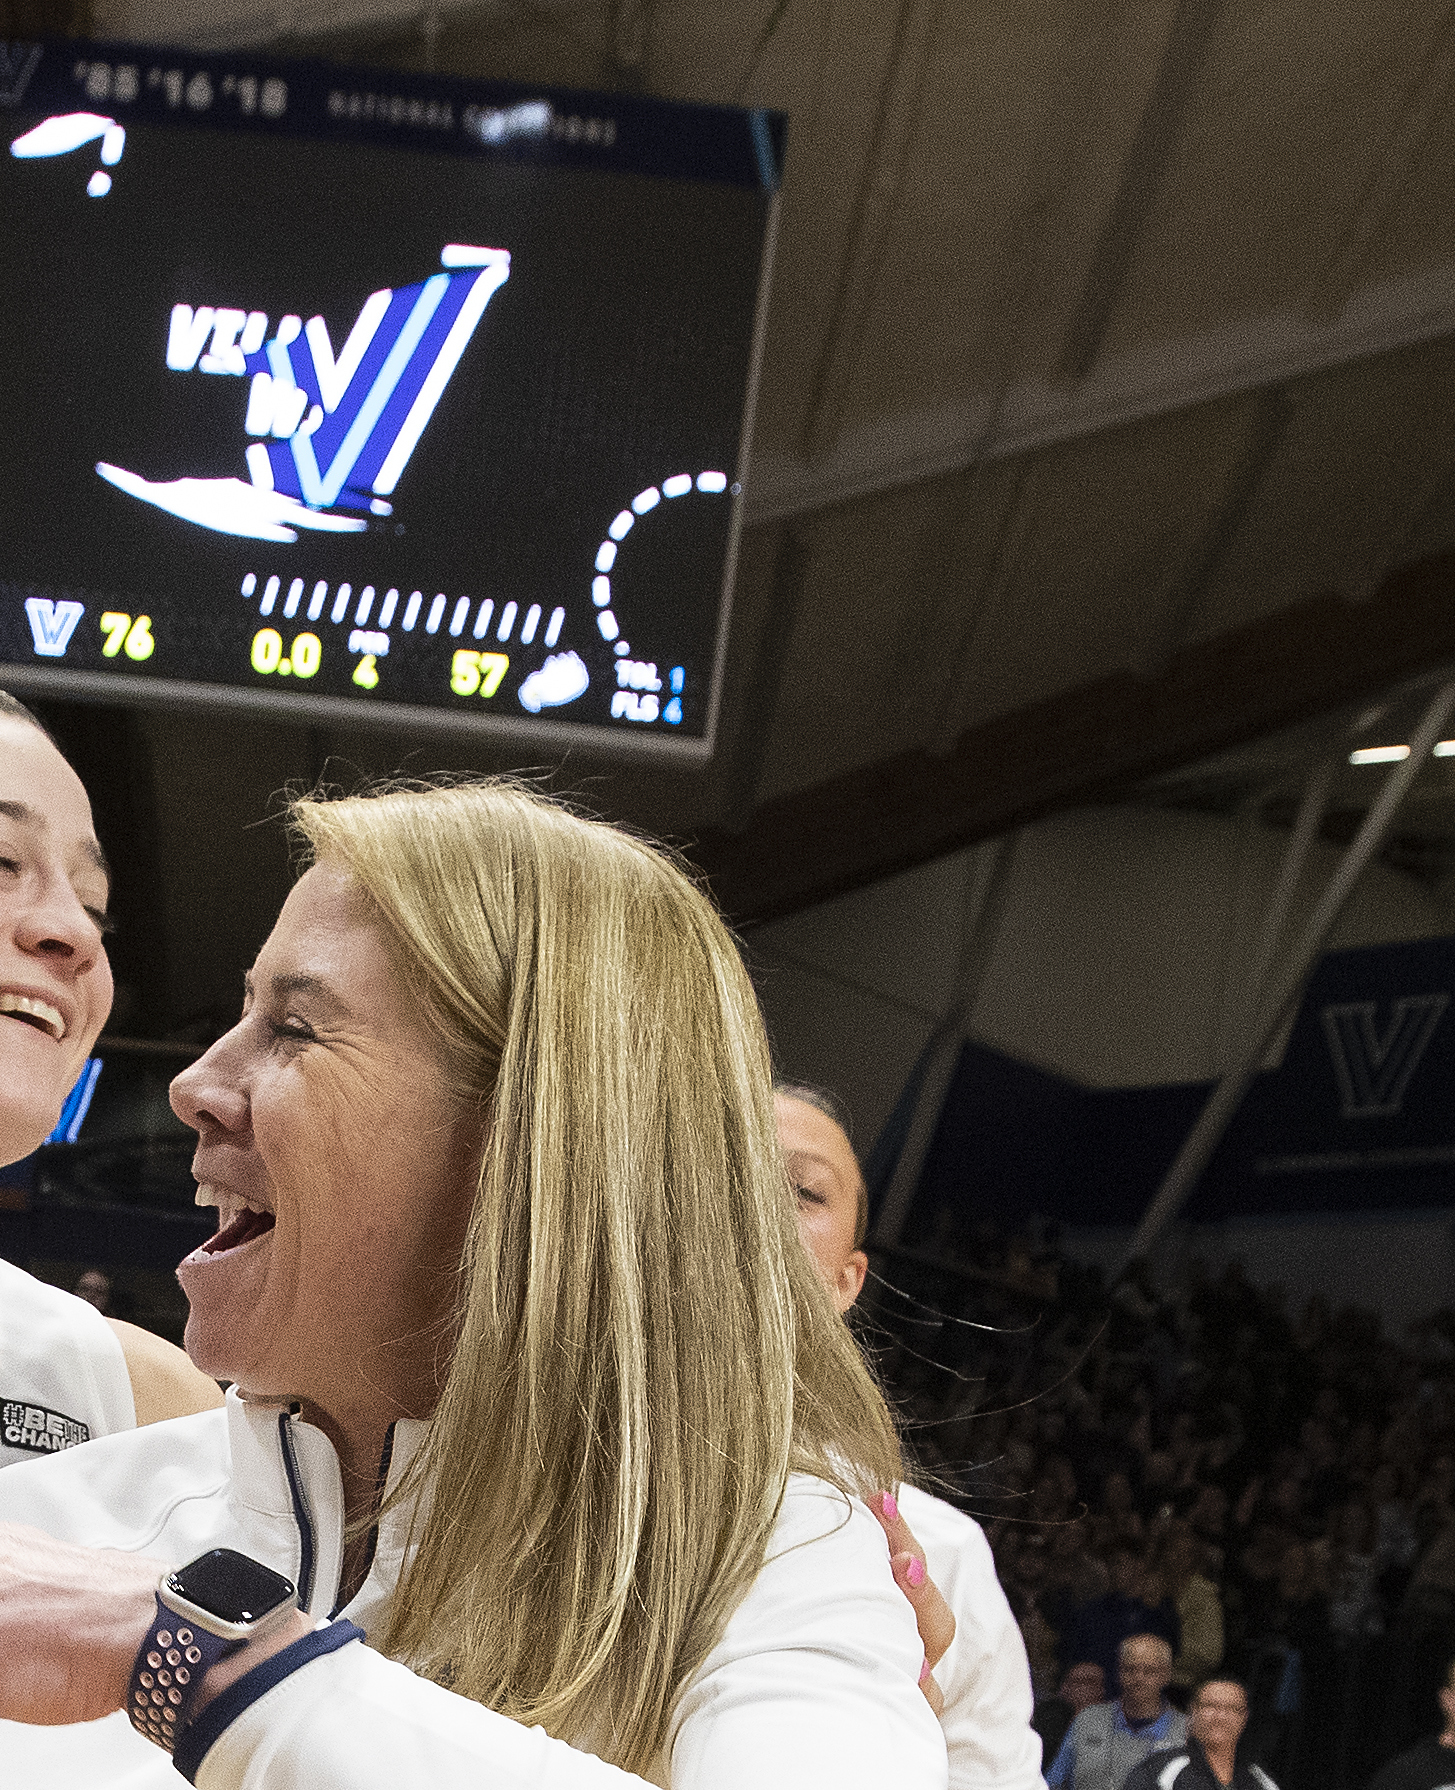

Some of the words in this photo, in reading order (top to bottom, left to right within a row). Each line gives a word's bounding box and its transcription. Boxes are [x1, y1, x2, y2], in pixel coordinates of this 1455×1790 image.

[100, 611, 155, 661] 76
[250, 627, 322, 679] 0.0
[450, 649, 509, 698] 57
[5, 1425, 78, 1451] CHAN
